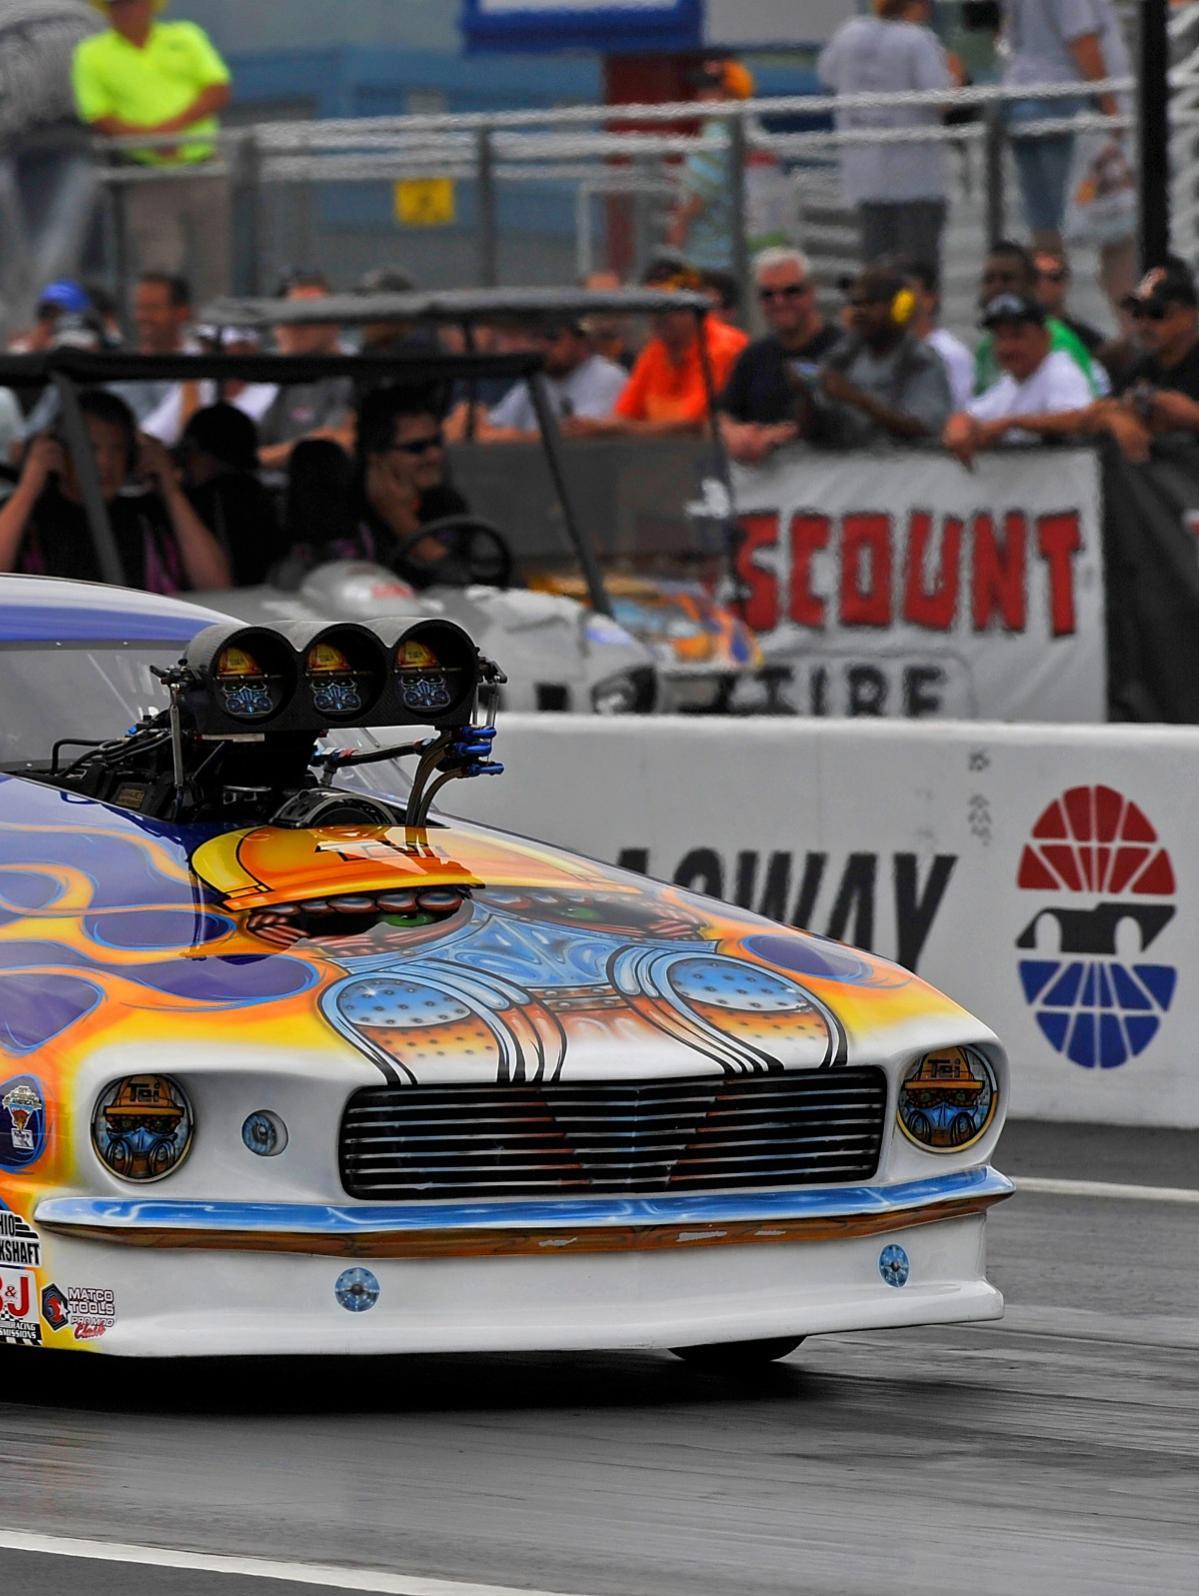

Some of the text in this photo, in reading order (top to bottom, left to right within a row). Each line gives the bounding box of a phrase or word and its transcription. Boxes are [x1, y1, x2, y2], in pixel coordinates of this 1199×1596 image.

[733, 507, 1081, 638] SCOUNT
[617, 847, 960, 975] WAY
[67, 1287, 114, 1303] MATCO
[69, 1300, 115, 1316] TOOLS
